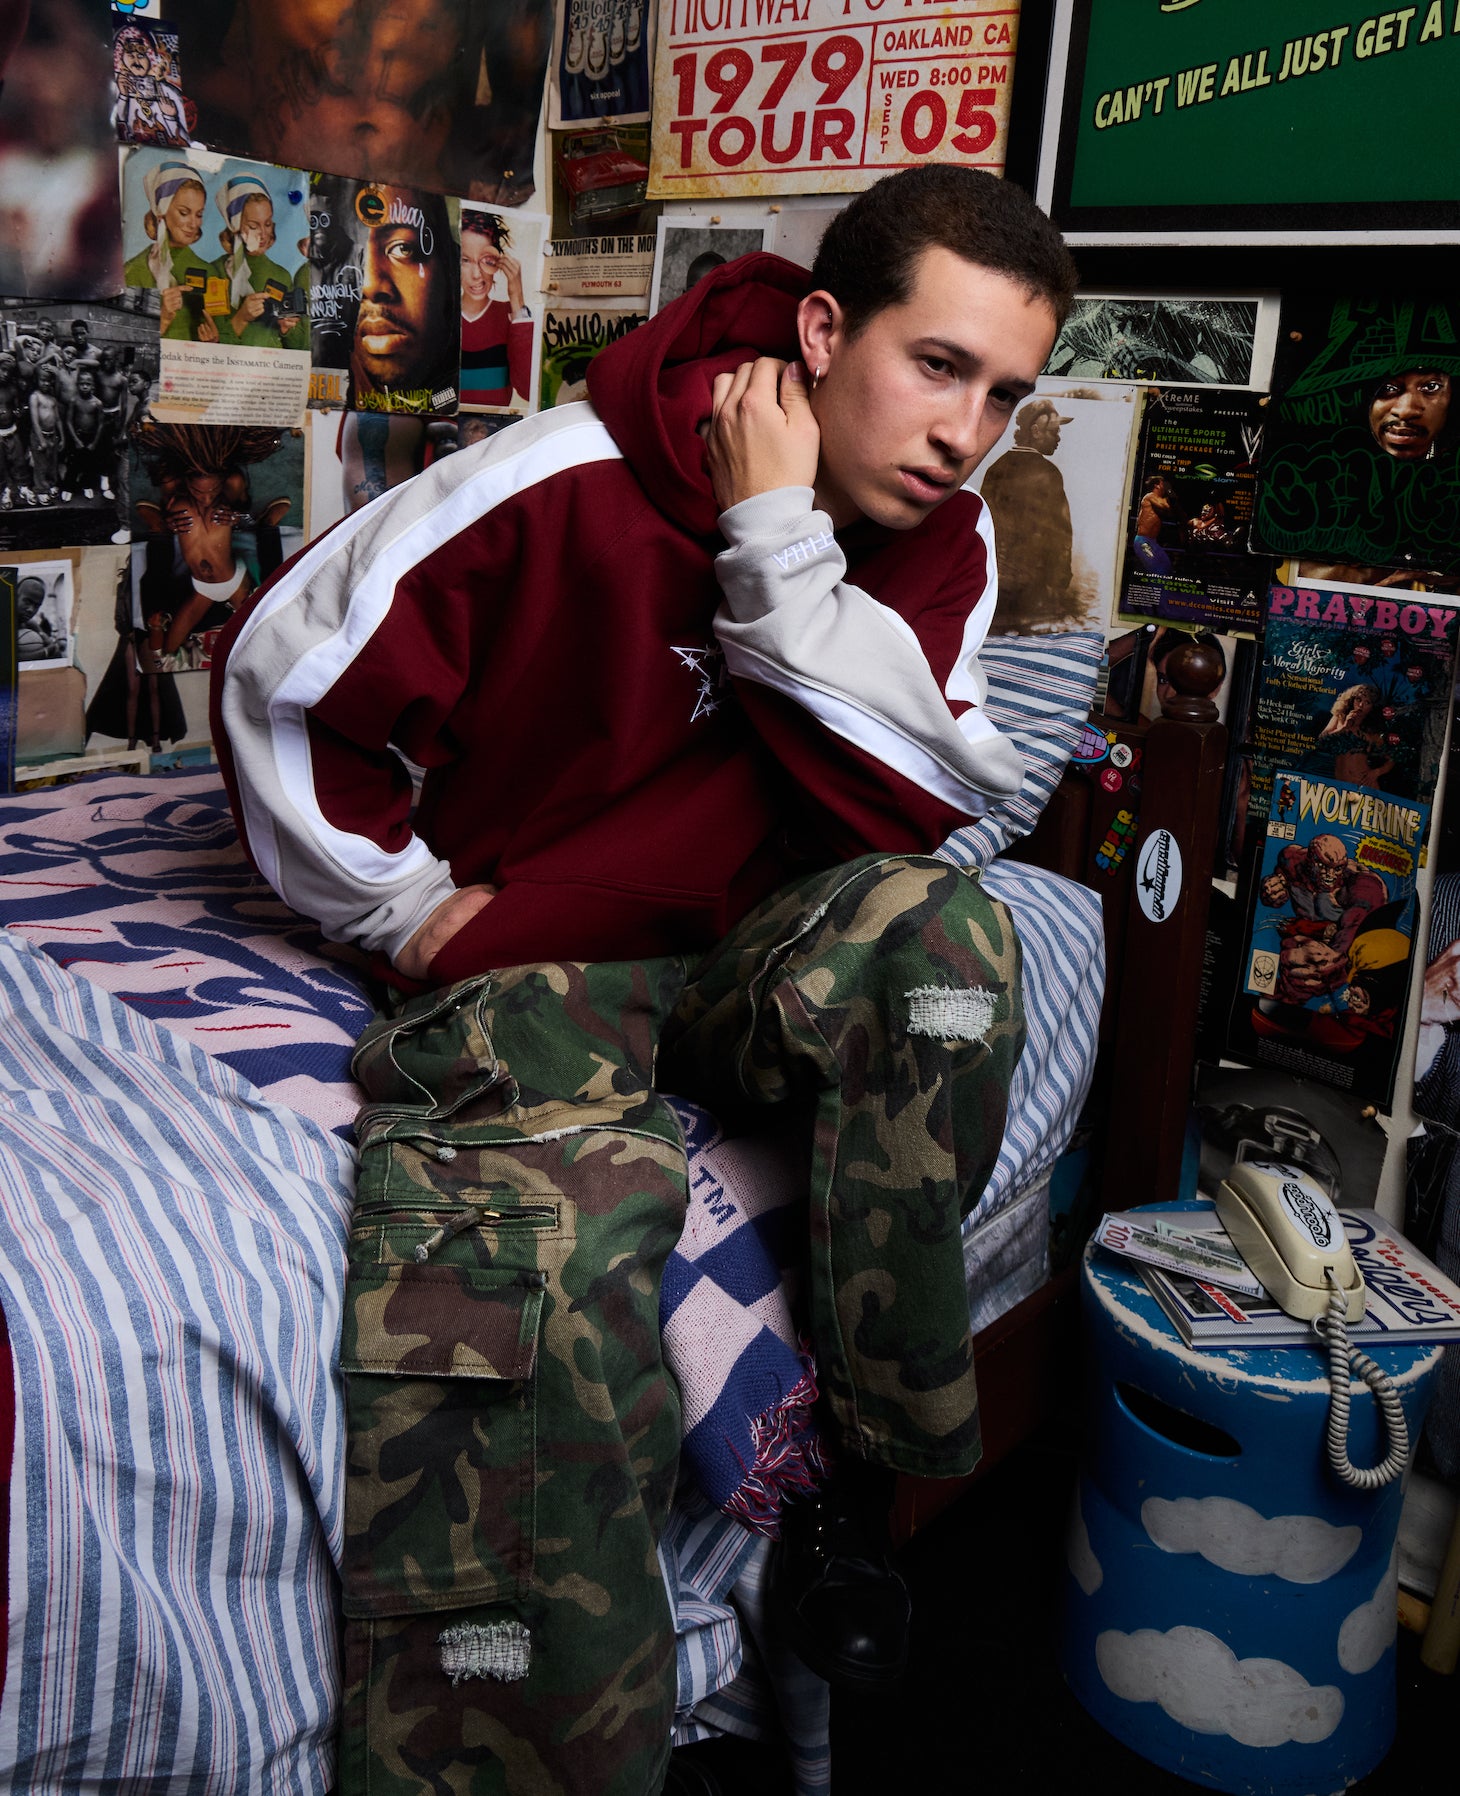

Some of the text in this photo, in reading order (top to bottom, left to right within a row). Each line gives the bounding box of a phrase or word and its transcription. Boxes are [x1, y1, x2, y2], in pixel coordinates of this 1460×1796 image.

[883, 23, 1011, 52] OAKLAND CA
[673, 34, 864, 116] 1979
[880, 65, 1007, 89] WED 8:00 PM
[1094, 77, 1171, 129] CAN'T
[1177, 63, 1218, 108] WE
[1220, 49, 1272, 97] ALL
[1278, 26, 1349, 81] JUST
[1355, 7, 1416, 59] GET
[1418, 0, 1443, 43] A
[880, 93, 892, 154] SEPT
[900, 88, 997, 154] 05
[670, 108, 856, 169] TOUR
[601, 238, 614, 253] ON
[618, 237, 634, 253] THE
[160, 352, 182, 362] odak
[184, 353, 210, 365] brings
[212, 356, 225, 365] the
[273, 360, 304, 370] Camera
[308, 374, 342, 400] REAL
[1213, 409, 1249, 417] PRESENTS
[1151, 426, 1227, 438] ULTIMATE SPORTS
[1156, 435, 1226, 447] ENTERTAINMENT
[1155, 442, 1236, 456] PRIZE PACKAGE from
[1268, 586, 1457, 639] PRAYBOY
[1298, 777, 1421, 848] WOLVERINE
[1095, 808, 1134, 871] SUPER
[1103, 1224, 1131, 1249] 100
[1377, 1249, 1406, 1269] LOS
